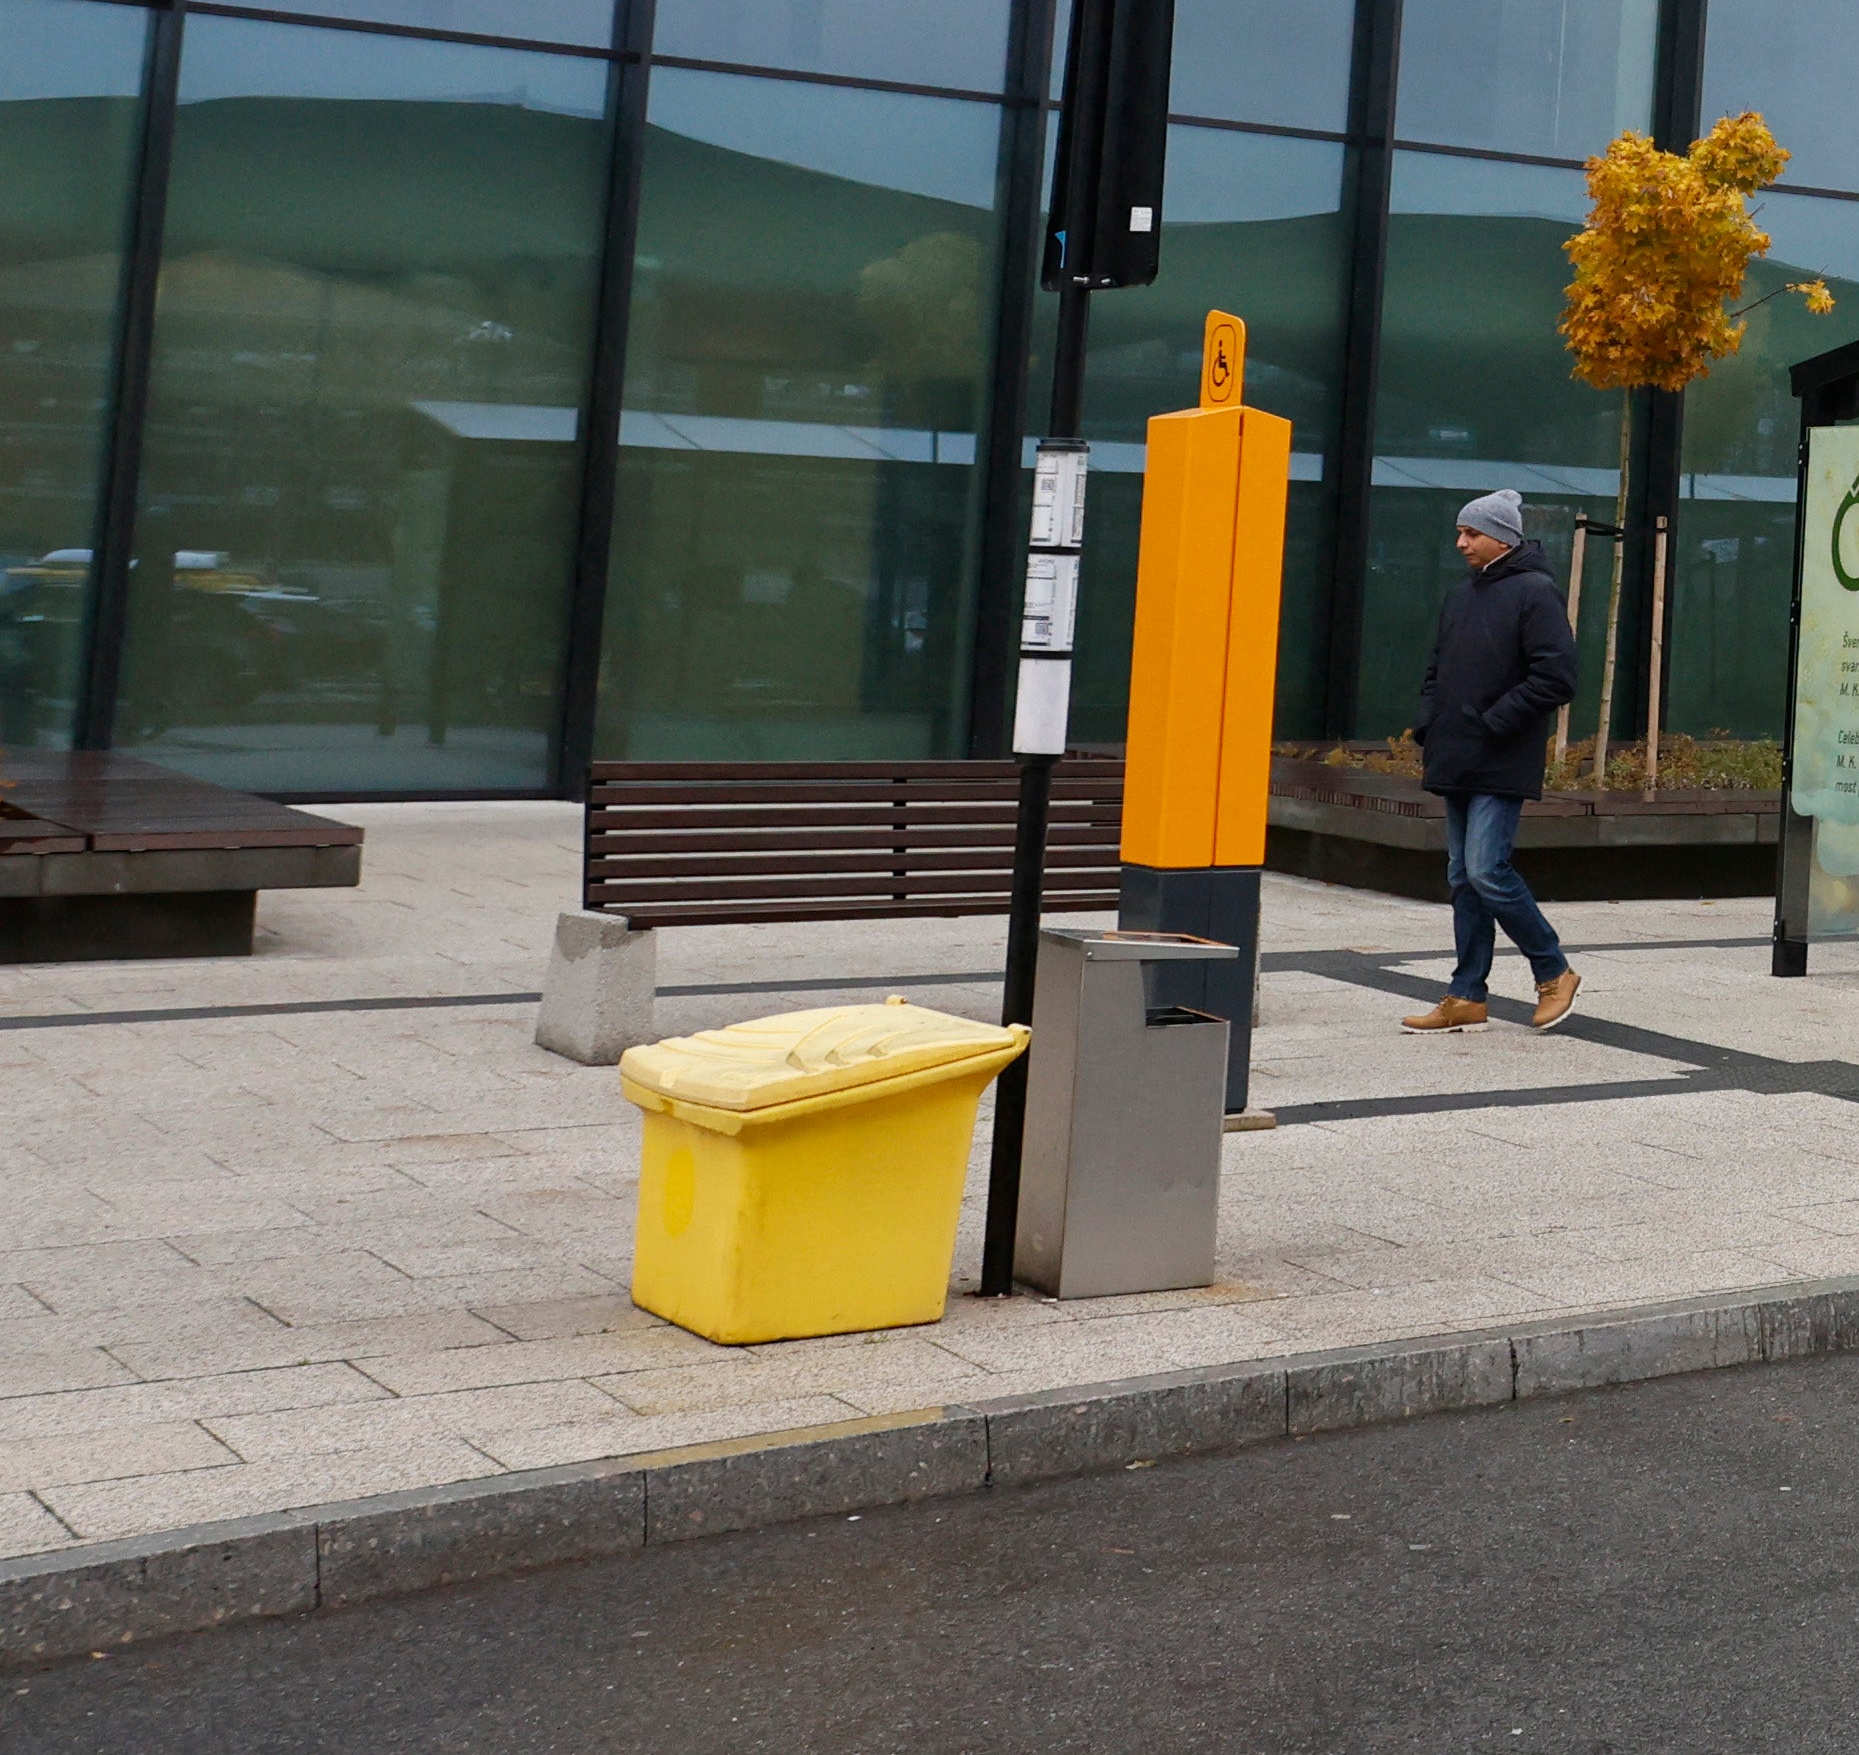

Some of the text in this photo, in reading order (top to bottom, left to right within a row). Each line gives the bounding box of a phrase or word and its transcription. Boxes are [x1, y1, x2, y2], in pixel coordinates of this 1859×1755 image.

[1840, 683, 1849, 696] M.
[1852, 684, 1859, 697] K.
[1836, 755, 1845, 768] M.
[1849, 755, 1857, 769] K.
[1835, 781, 1857, 794] most
